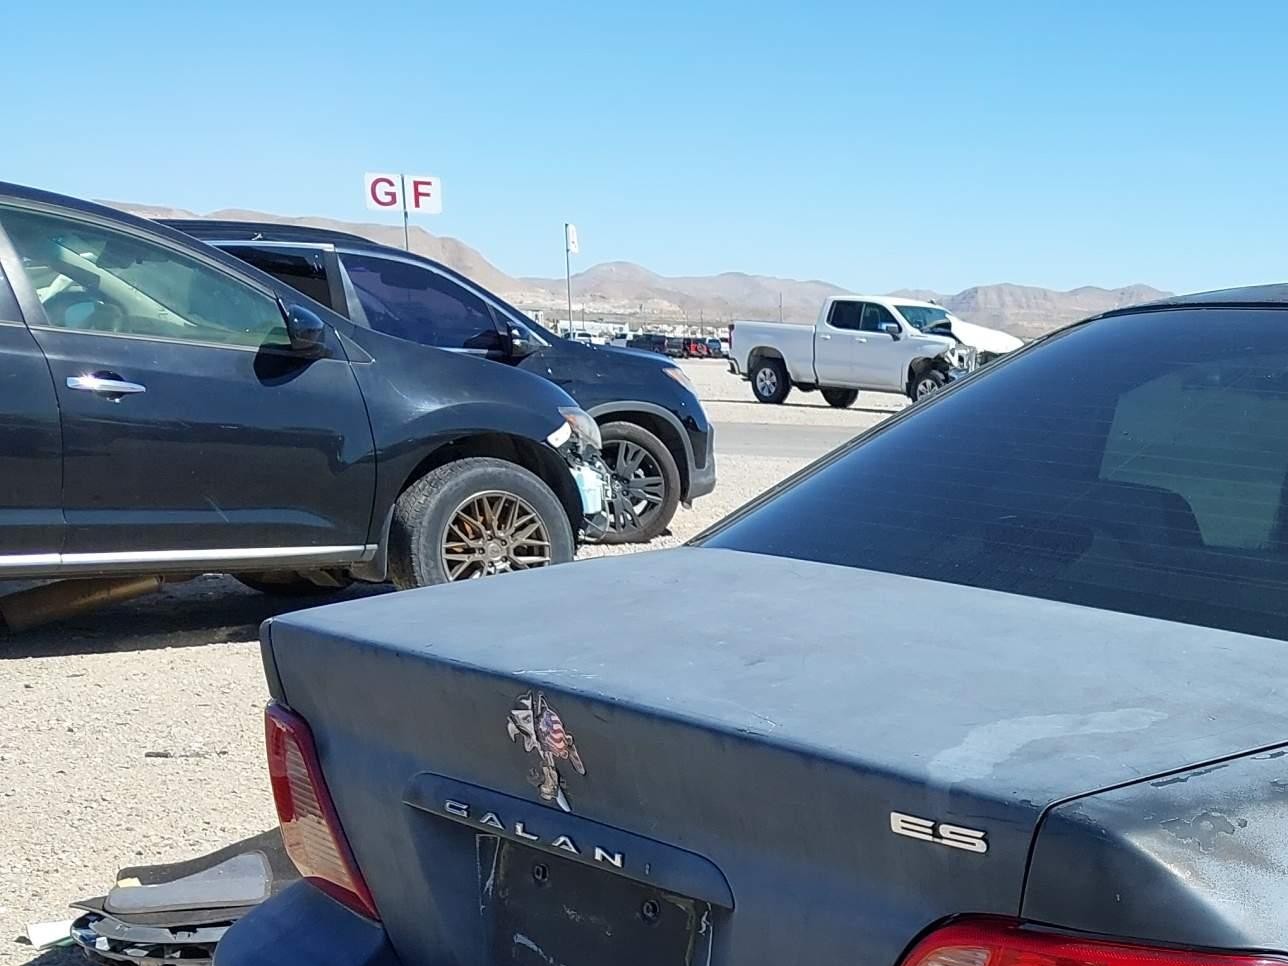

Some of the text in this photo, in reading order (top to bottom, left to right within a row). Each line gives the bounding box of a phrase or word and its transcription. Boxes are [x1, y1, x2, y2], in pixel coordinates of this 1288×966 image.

[370, 177, 397, 207] G
[413, 180, 433, 209] F
[890, 811, 988, 853] ES
